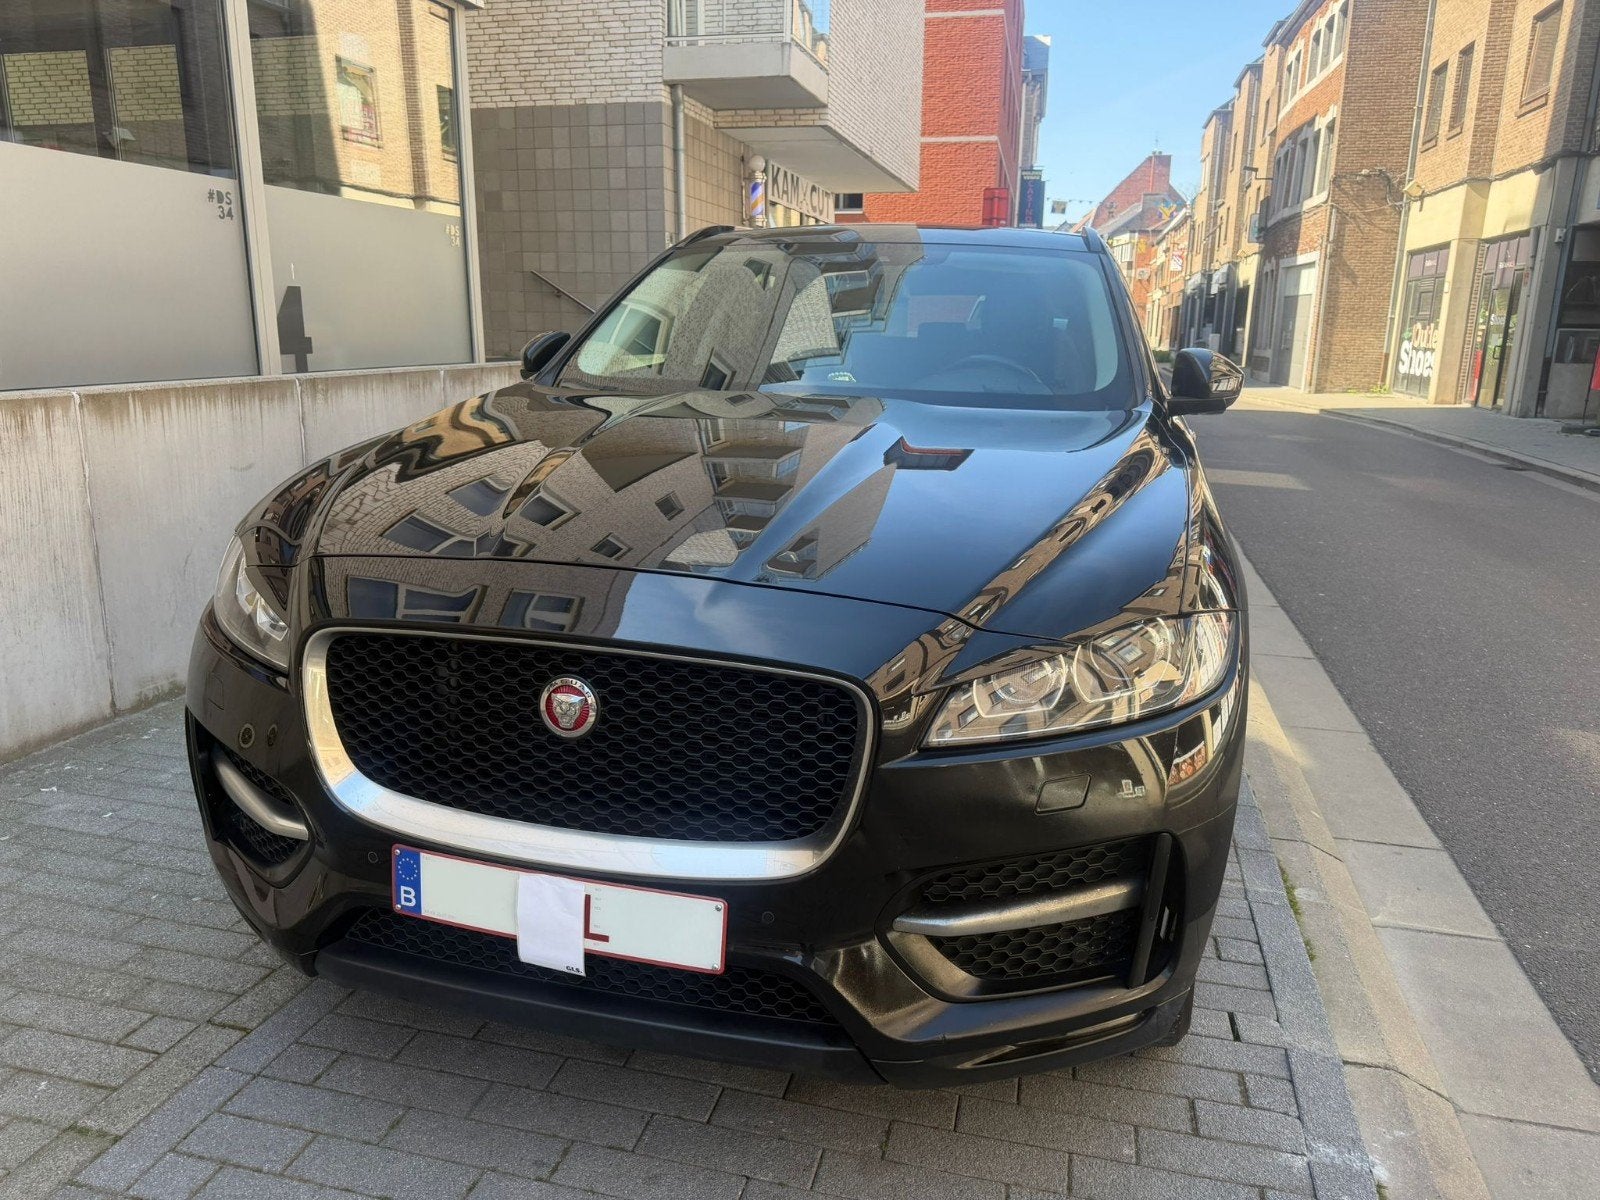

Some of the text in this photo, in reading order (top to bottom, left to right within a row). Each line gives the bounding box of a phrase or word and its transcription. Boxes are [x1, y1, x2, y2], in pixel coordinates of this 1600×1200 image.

[218, 205, 233, 220] 34
[1412, 322, 1439, 349] Outle
[400, 885, 417, 907] B
